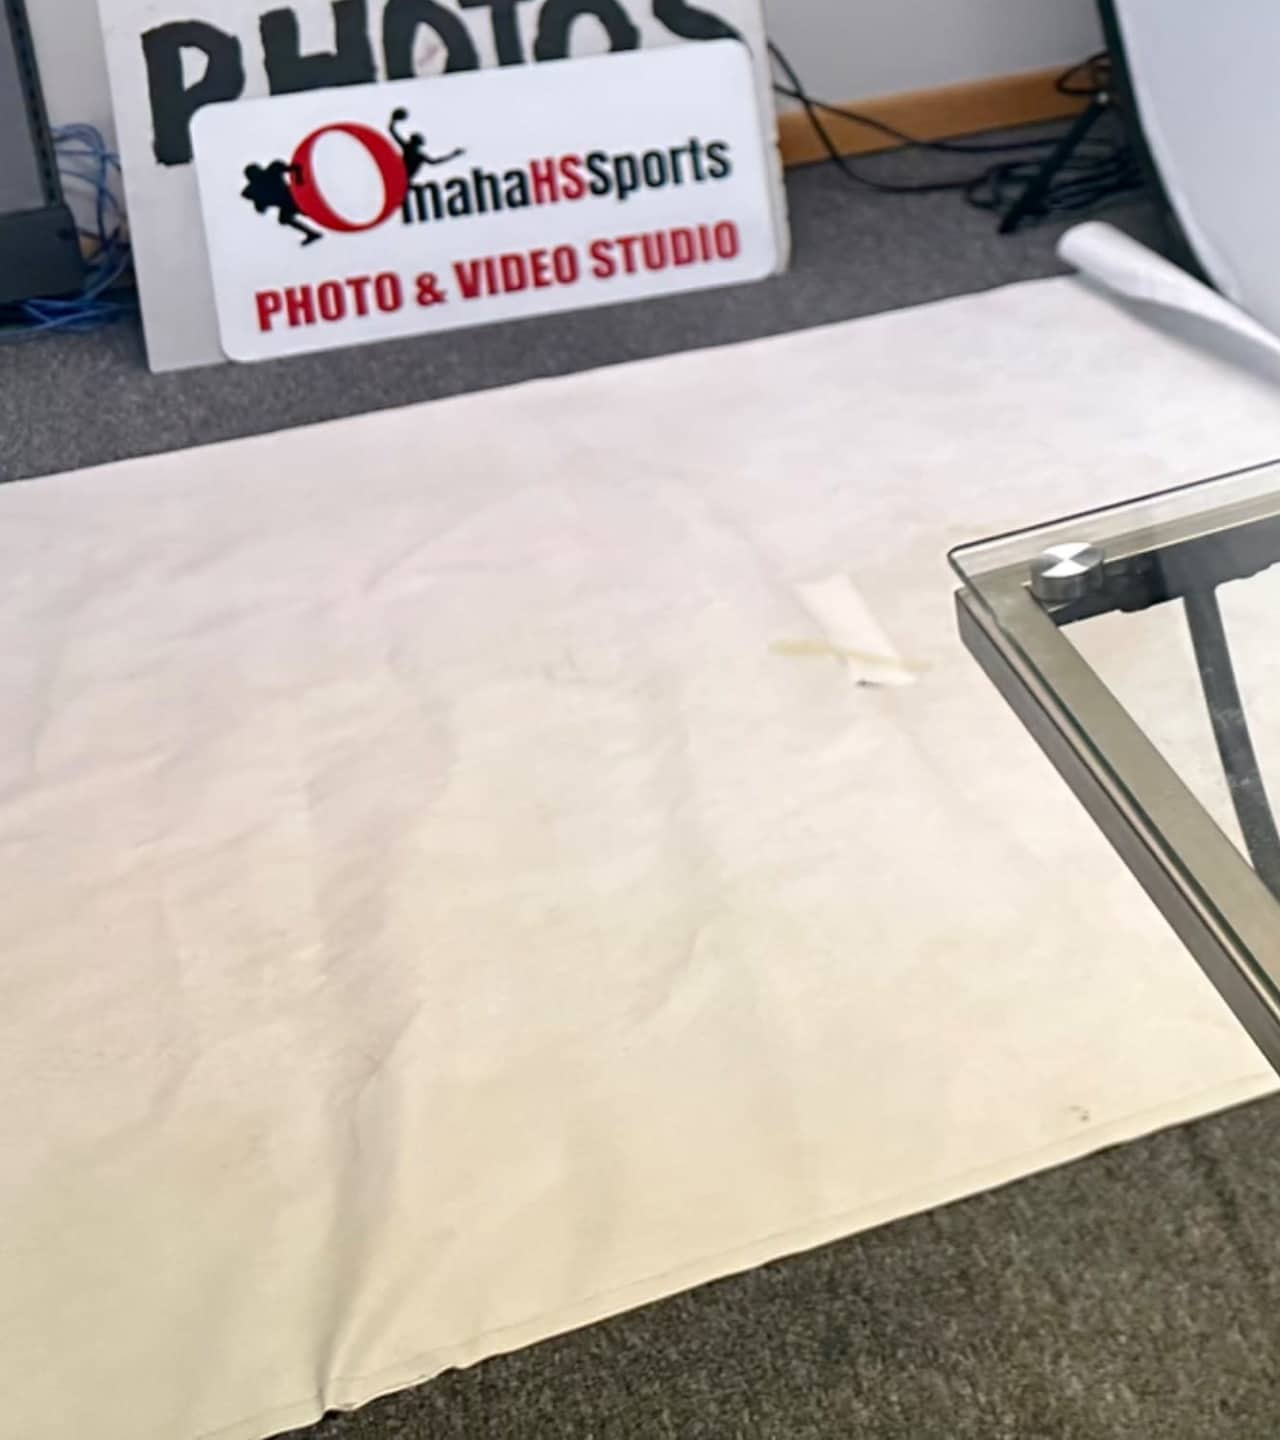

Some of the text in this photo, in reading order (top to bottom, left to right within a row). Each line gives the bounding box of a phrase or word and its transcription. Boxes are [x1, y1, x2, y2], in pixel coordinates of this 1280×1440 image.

[288, 121, 732, 233] OmahaHSSports
[255, 219, 740, 333] PHOTO & VIDEO STUDIO
